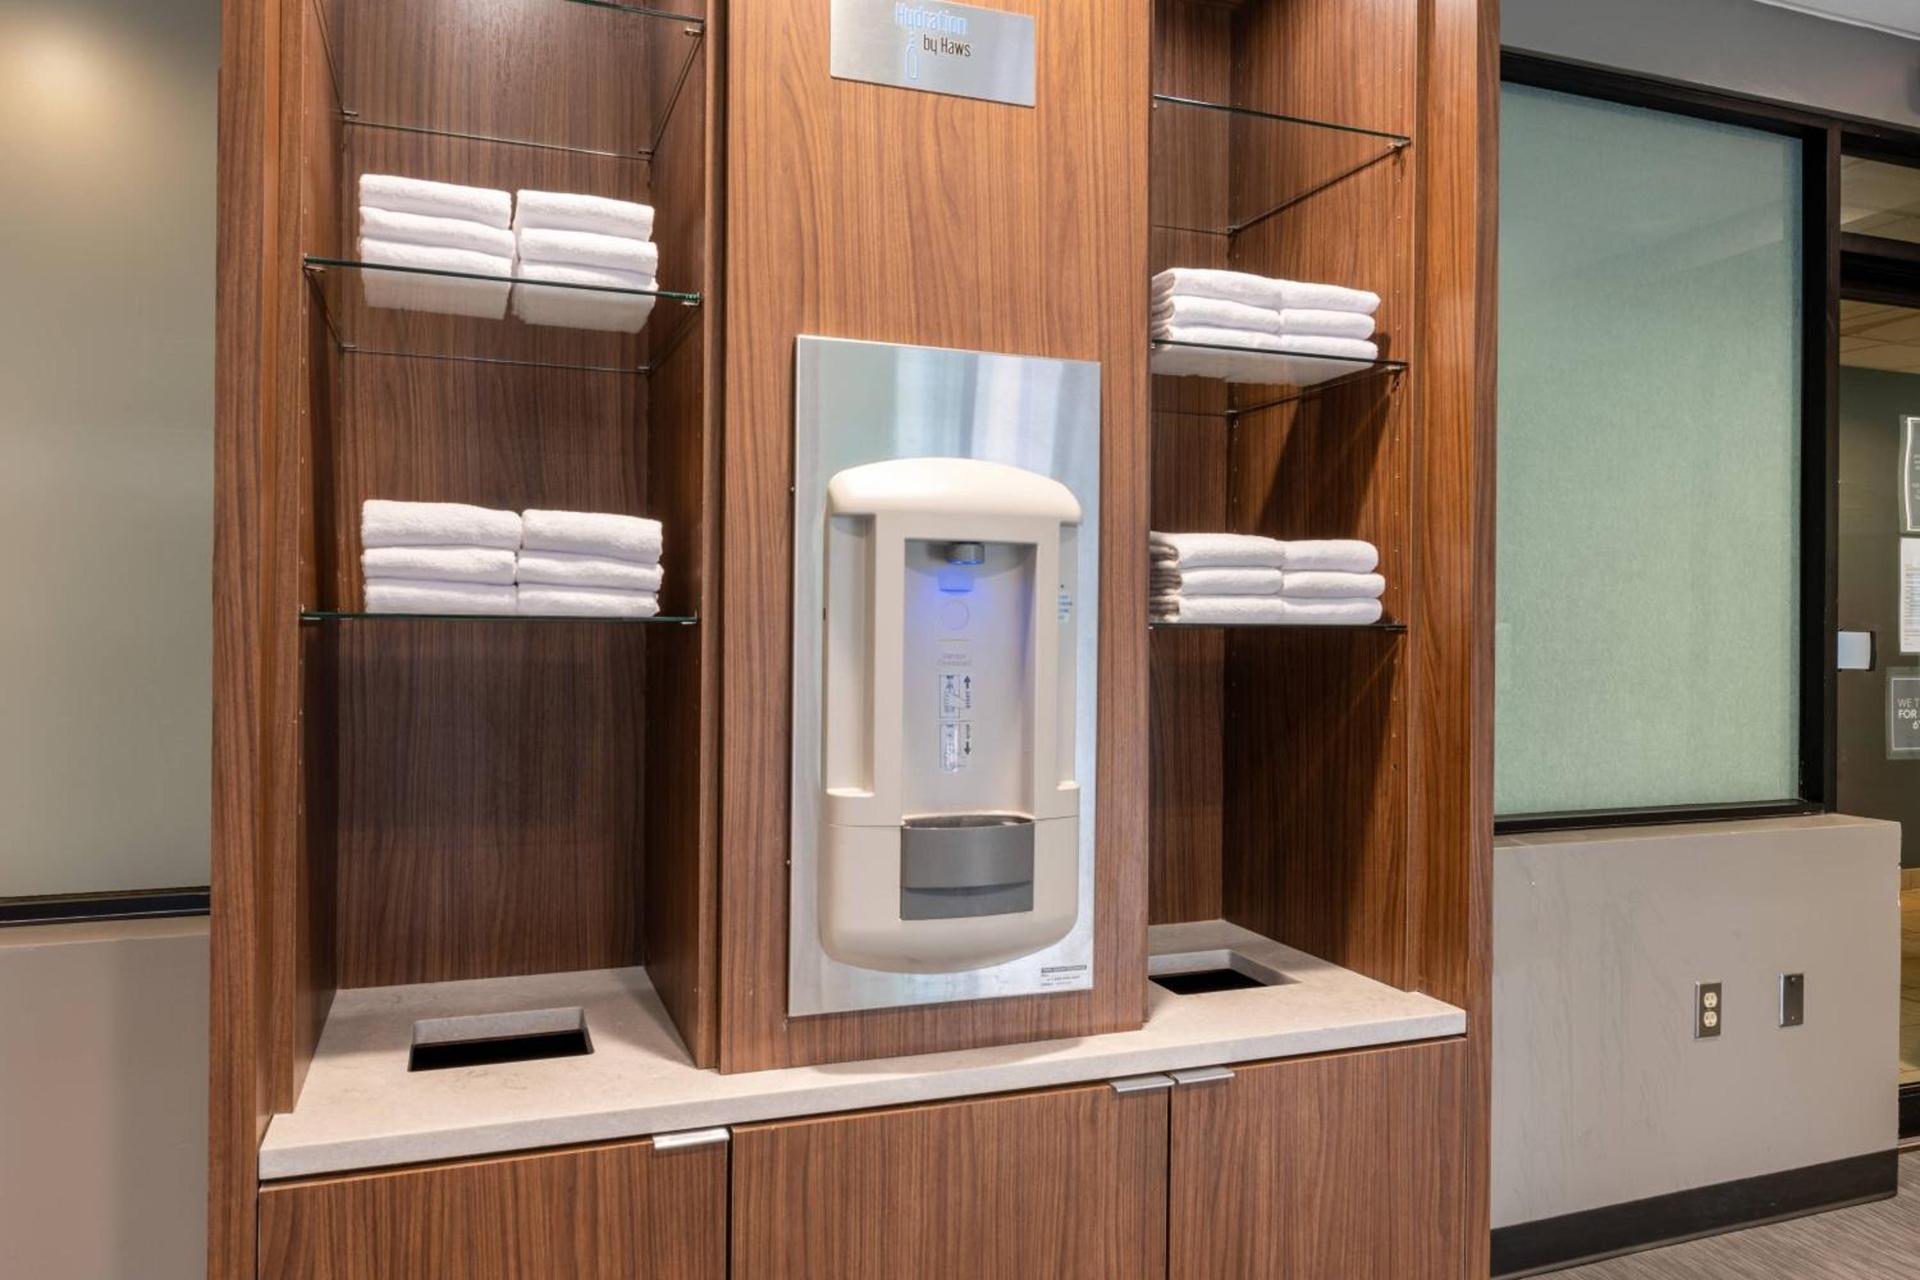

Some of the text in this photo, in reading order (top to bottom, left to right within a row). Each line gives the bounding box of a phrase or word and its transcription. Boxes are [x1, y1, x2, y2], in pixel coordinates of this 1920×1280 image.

[923, 34, 972, 57] by Haws
[1898, 708, 1918, 719] FOR
